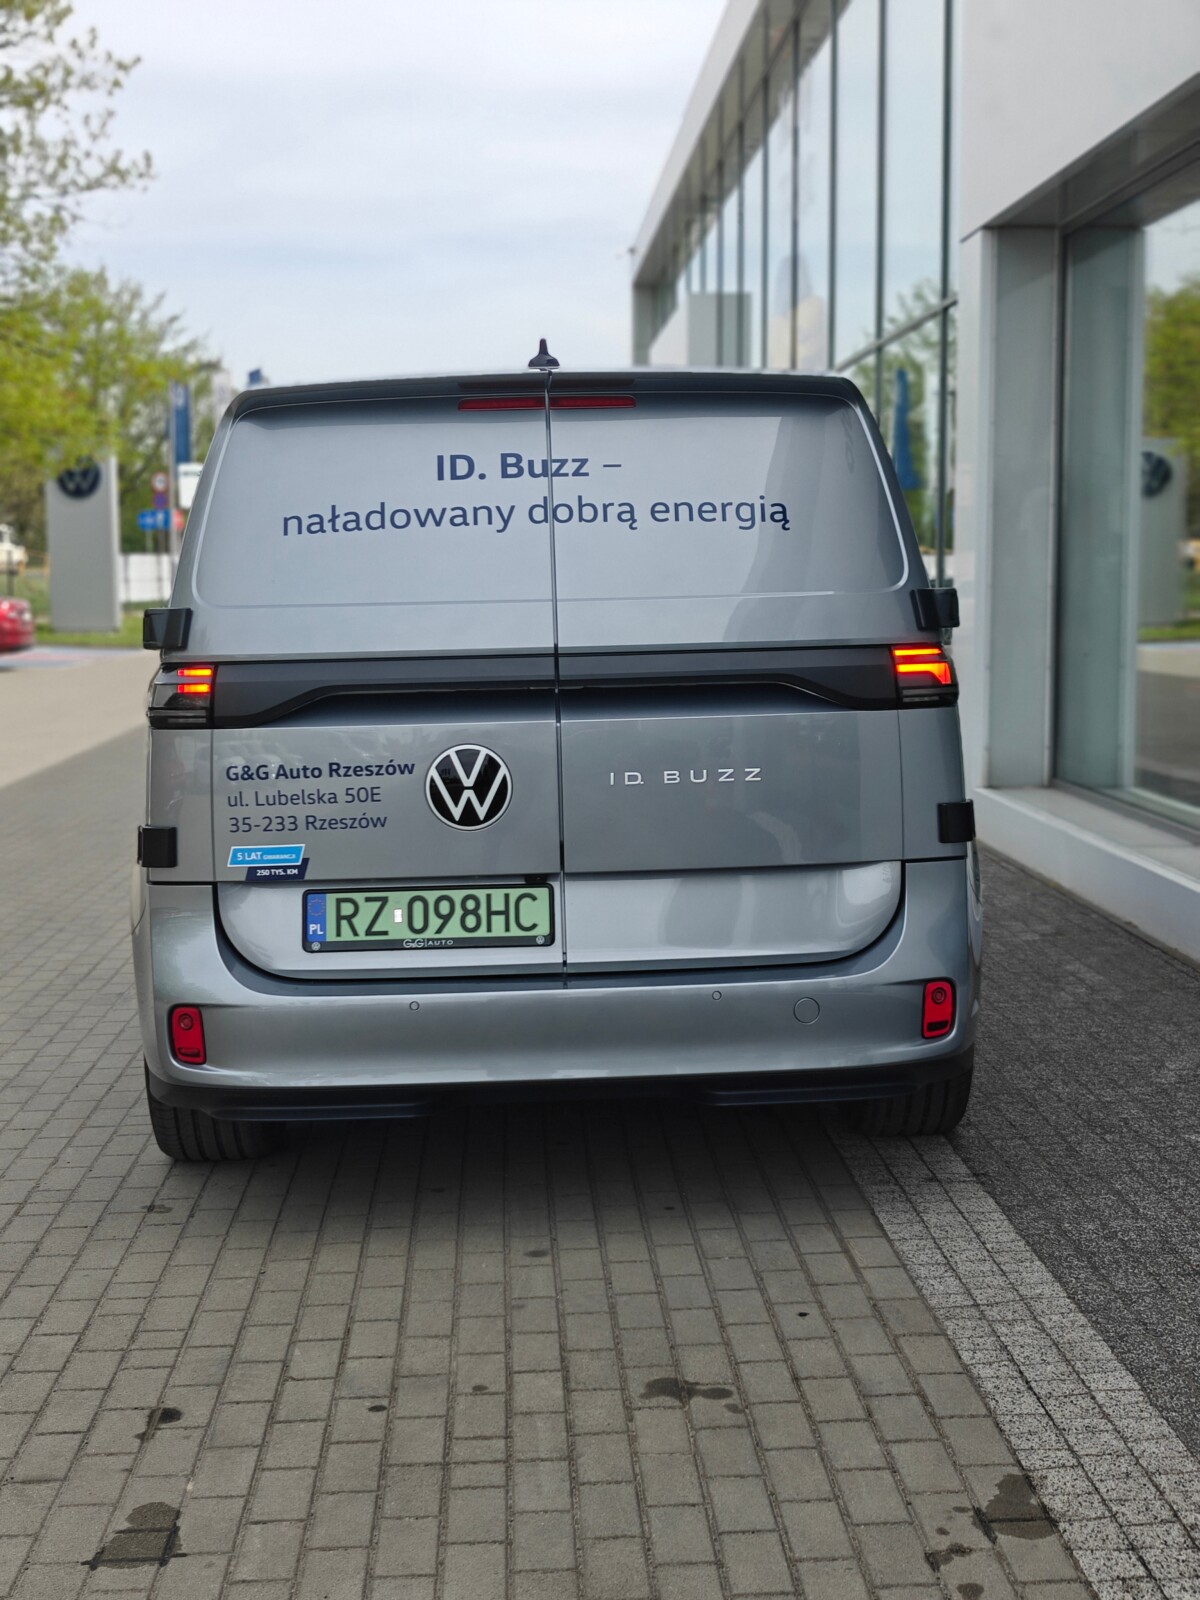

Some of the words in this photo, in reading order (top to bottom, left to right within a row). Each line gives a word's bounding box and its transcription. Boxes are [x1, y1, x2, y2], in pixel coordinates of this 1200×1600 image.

[436, 454, 487, 481] ID.
[499, 452, 590, 479] Buzz
[282, 500, 516, 536] naładowany
[527, 494, 639, 531] dobrą
[649, 494, 791, 531] energią
[226, 764, 270, 782] G&G
[275, 764, 322, 780] Auto
[328, 759, 416, 778] Rzeszów
[663, 768, 762, 784] BUZZ
[227, 790, 249, 808] ul.
[255, 788, 337, 807] Lubelska
[344, 786, 382, 803] 50E
[229, 815, 299, 833] 35-233
[305, 812, 388, 831] Rzeszów
[236, 852, 243, 861] 5
[245, 852, 262, 860] LAT
[335, 896, 390, 938] RZ
[406, 892, 540, 936] 098HC
[309, 923, 324, 936] PL
